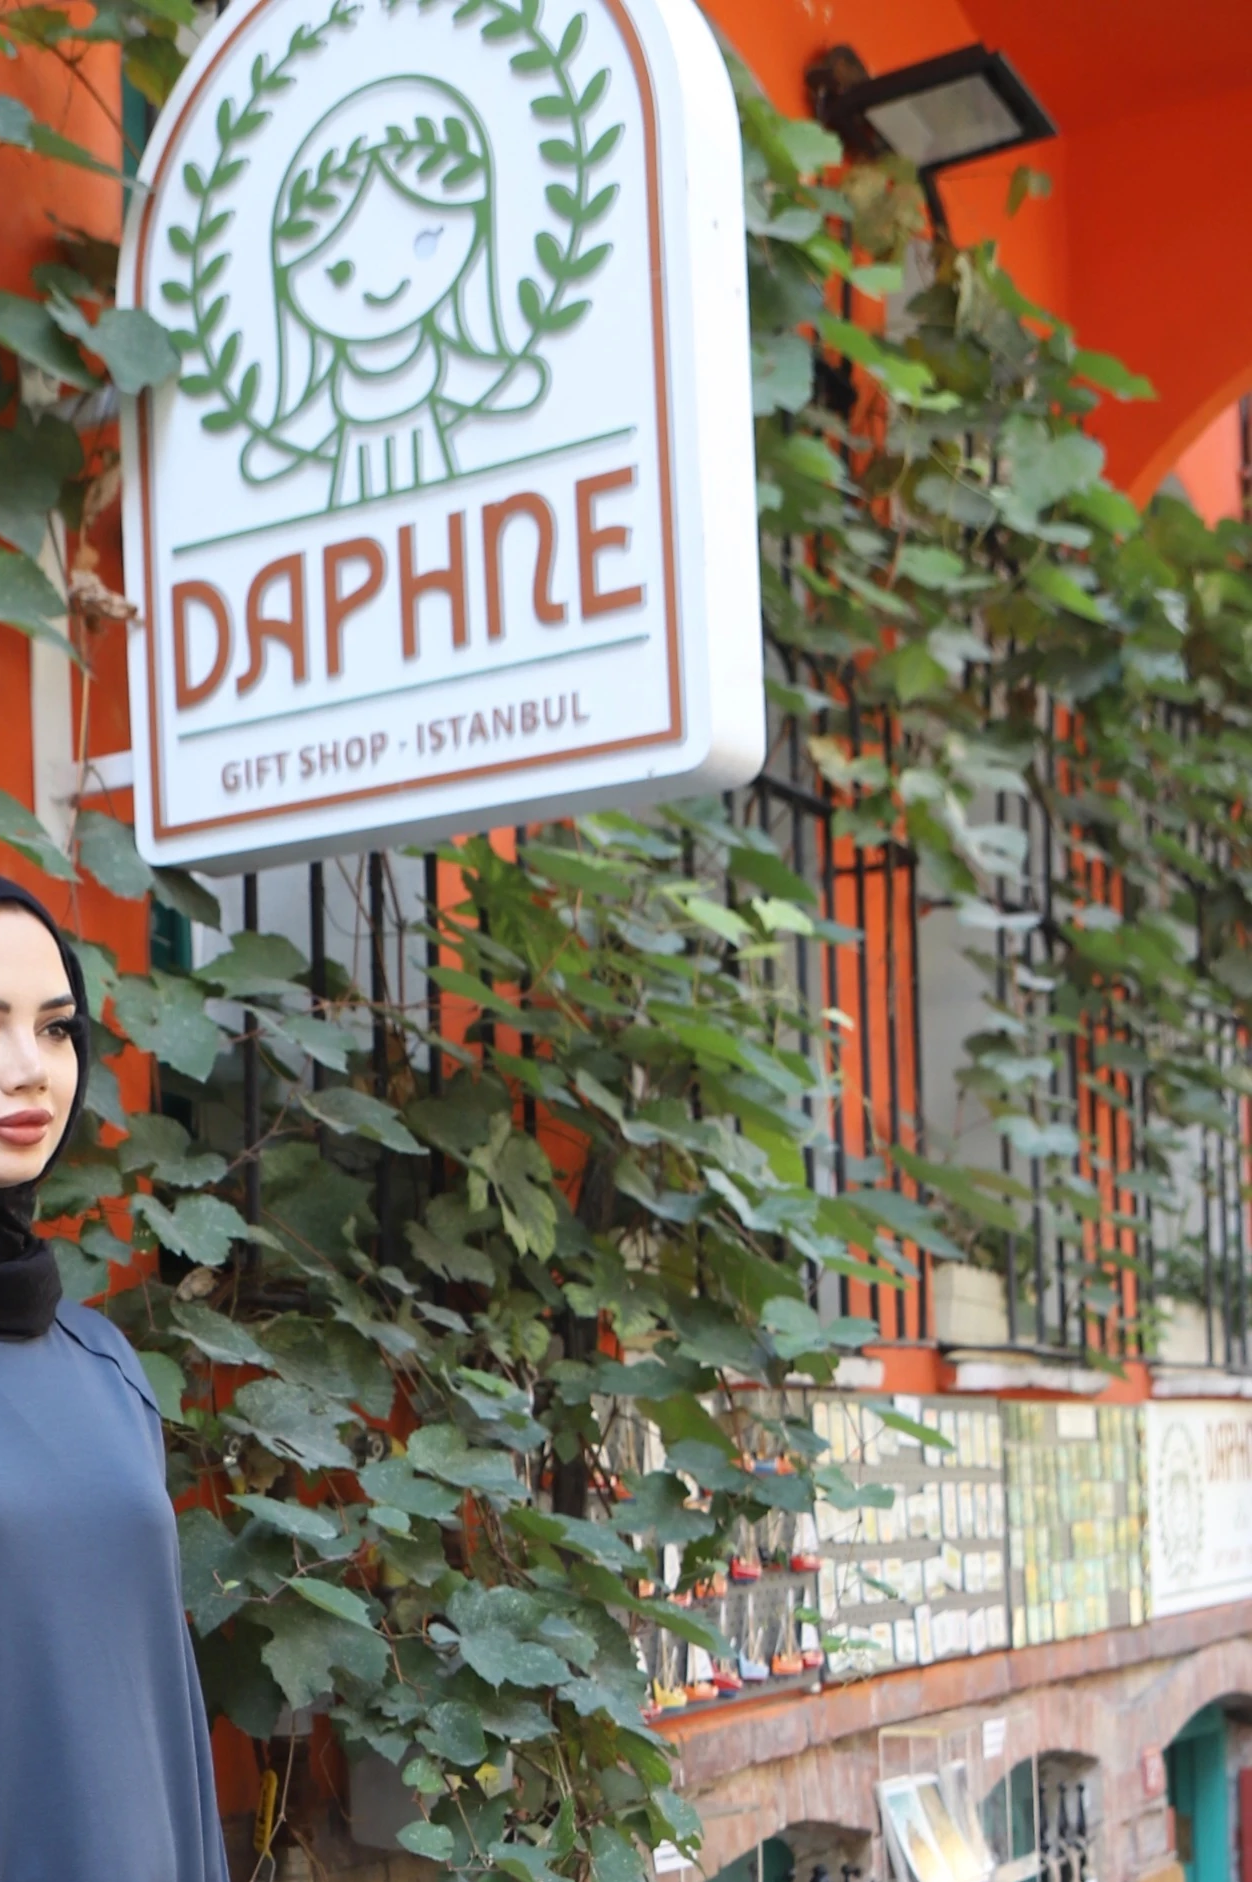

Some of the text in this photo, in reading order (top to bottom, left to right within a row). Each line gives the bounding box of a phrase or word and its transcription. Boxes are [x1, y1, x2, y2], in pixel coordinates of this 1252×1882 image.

[172, 466, 645, 711] DAPHNE
[221, 749, 291, 794] GIFT
[299, 730, 388, 779] SHOP
[416, 691, 591, 755] ISTANBUL
